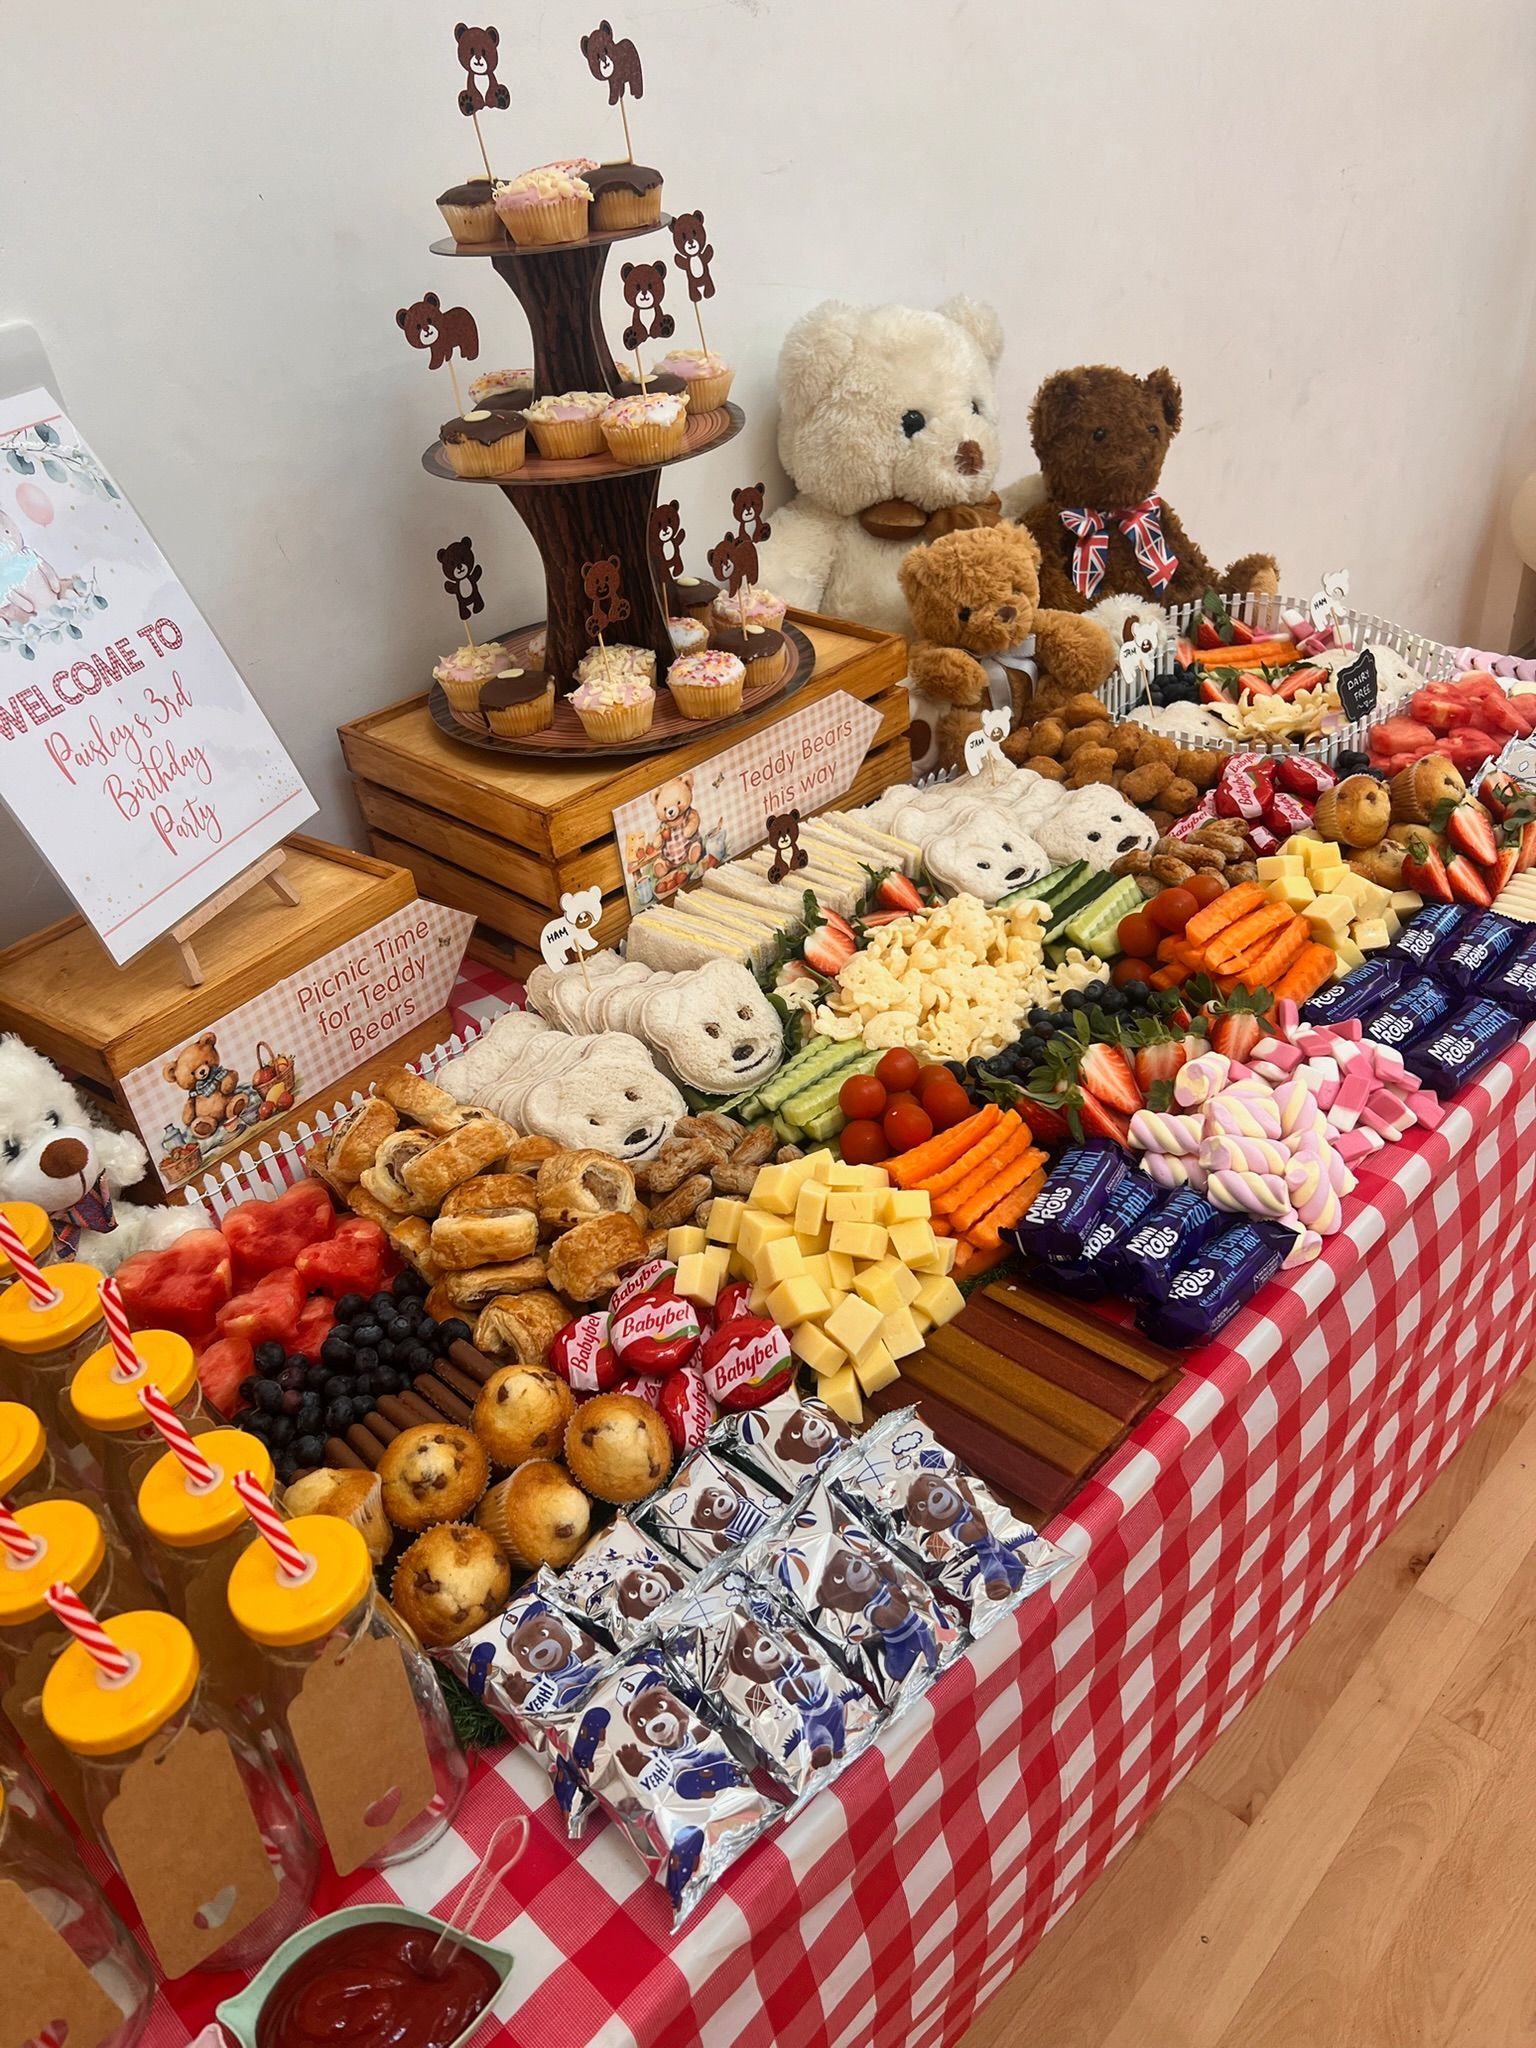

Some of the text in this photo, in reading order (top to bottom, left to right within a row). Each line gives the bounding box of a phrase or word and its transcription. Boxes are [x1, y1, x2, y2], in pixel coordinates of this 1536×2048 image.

[0, 617, 183, 741] WELCOME TO
[1346, 669, 1370, 690] DAIRY
[1353, 684, 1371, 701] FREE
[44, 670, 193, 785] Paisley's 3rd
[970, 738, 985, 749] JAM
[739, 721, 853, 793] Teddy Bears
[103, 740, 213, 821] Birthday
[763, 761, 837, 814] this way
[151, 797, 223, 856] Party
[546, 926, 569, 944] HAM
[1410, 929, 1435, 957] ROLLS
[297, 921, 430, 1013] Picnic Time
[1464, 943, 1489, 971] ROLLS
[319, 955, 425, 1035] for Teddy
[349, 998, 416, 1051] Bears
[1381, 1016, 1414, 1045] ROLLS
[1471, 1007, 1511, 1043] MIGHTY
[1442, 1036, 1475, 1067] ROLLS
[1073, 1152, 1105, 1173] ROLL
[1041, 1187, 1072, 1219] ROLLS
[1121, 1186, 1154, 1219] ROLL
[1116, 1211, 1134, 1228] A
[1081, 1223, 1115, 1260] ROLLS
[1143, 1226, 1179, 1259] ROLLS
[1224, 1248, 1245, 1268] AND
[611, 1260, 663, 1311] Babybel
[1175, 1268, 1215, 1299] ROLLS
[1207, 1271, 1237, 1301] CHOCOLATE
[622, 1304, 690, 1338] Babybel
[571, 1315, 600, 1373] Babybel
[715, 1335, 778, 1391] Babybel
[688, 1371, 711, 1448] Babybel
[505, 1613, 518, 1625] B
[525, 1681, 555, 1713] YEAH!
[622, 1681, 635, 1694] B
[640, 1759, 671, 1791] YEAH!
